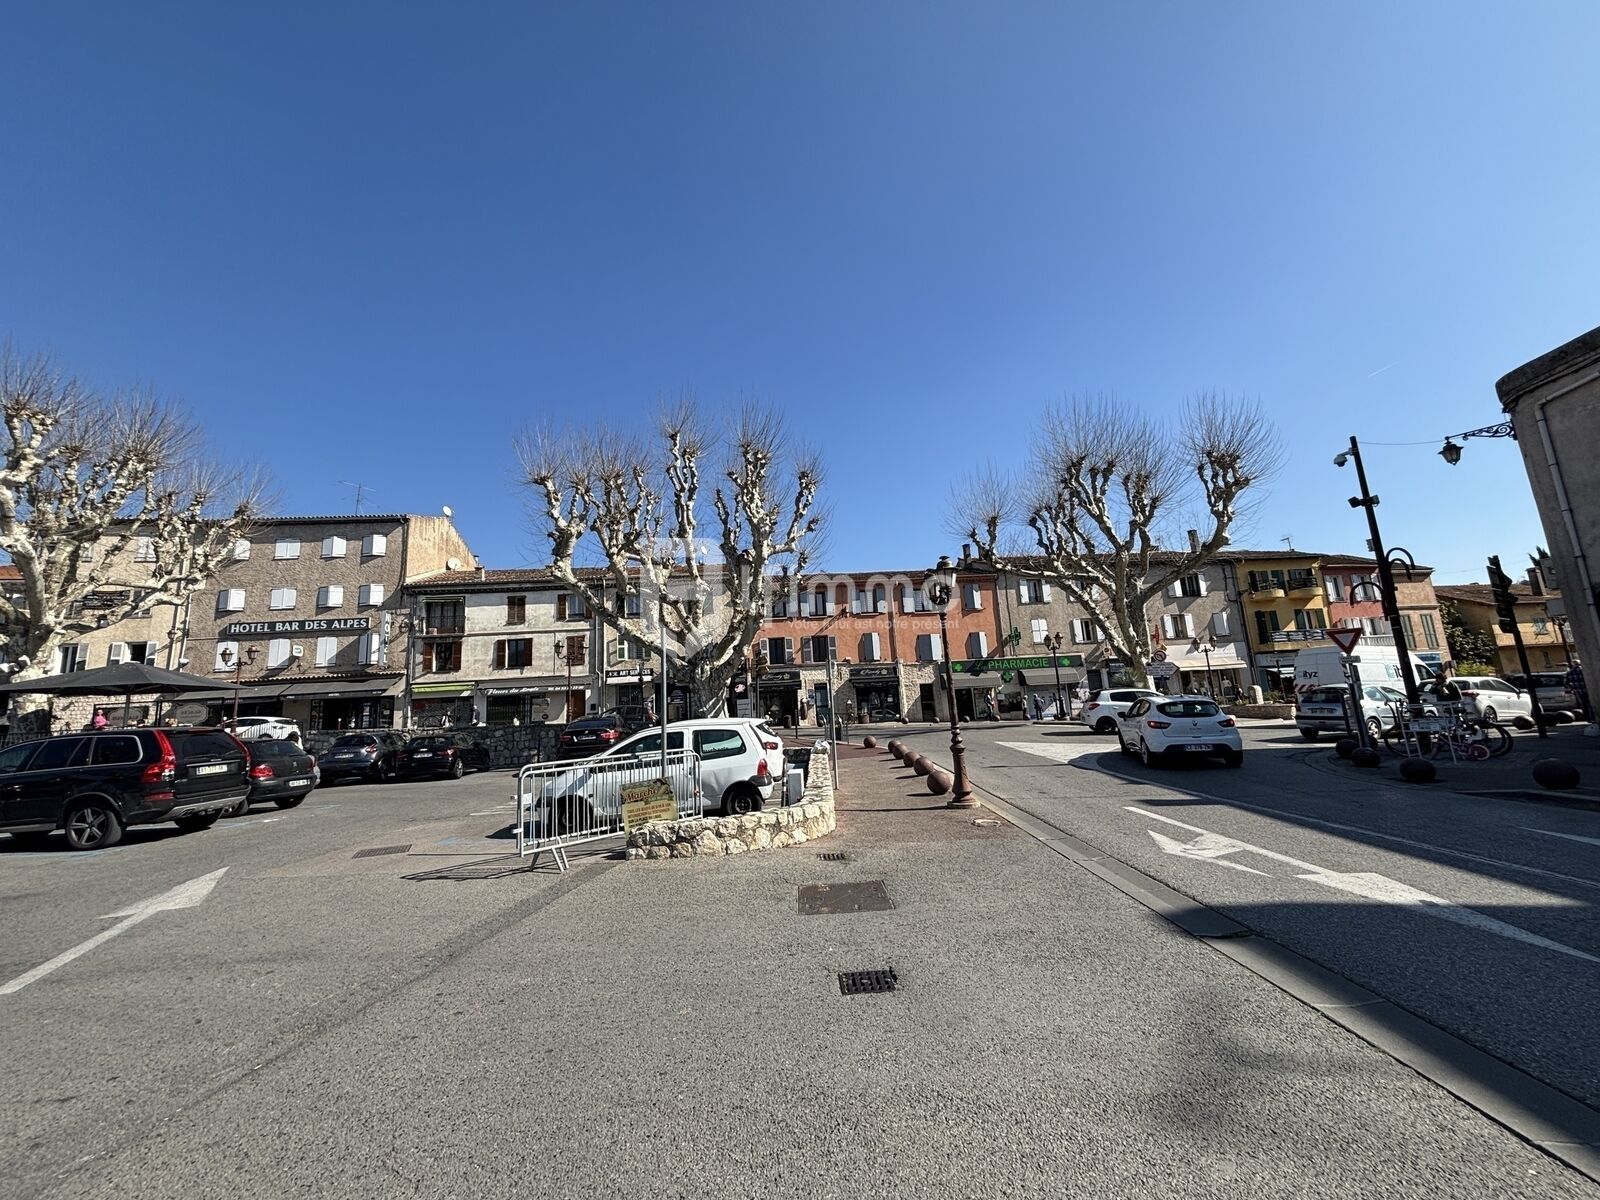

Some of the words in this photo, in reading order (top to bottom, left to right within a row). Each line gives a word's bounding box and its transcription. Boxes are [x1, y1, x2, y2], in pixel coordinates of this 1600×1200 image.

[230, 623, 270, 633] HOTEL
[275, 621, 299, 631] BAR
[304, 620, 327, 630] DES
[331, 618, 367, 629] ALPES
[988, 658, 1050, 670] PHARMACIE
